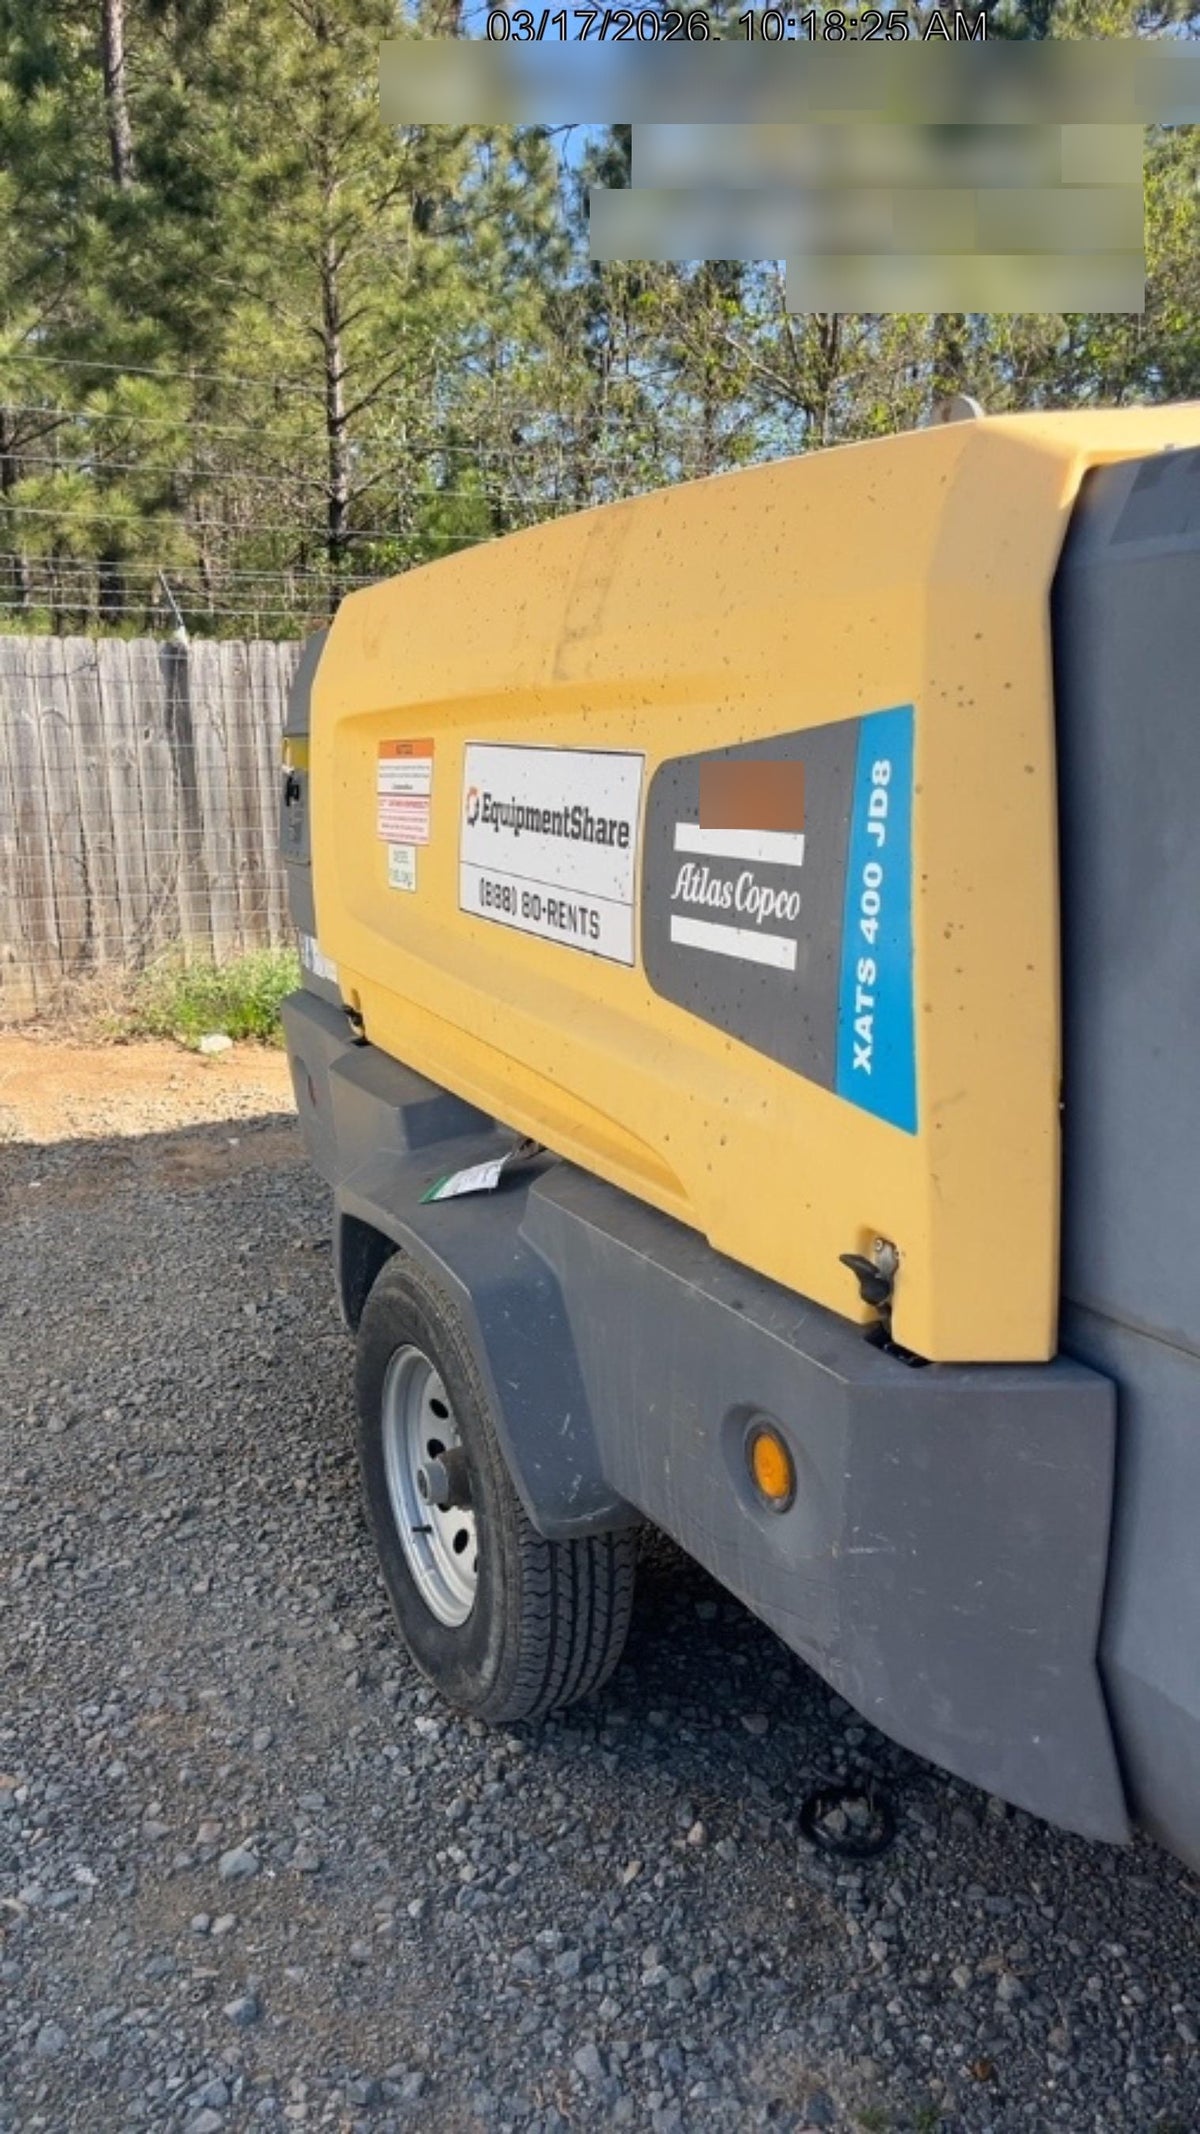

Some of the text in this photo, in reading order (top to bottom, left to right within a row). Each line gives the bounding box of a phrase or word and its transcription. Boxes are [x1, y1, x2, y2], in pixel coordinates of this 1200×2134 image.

[481, 792, 630, 848] EquipmentShare
[479, 877, 601, 940] (888) 80-RENTS
[671, 861, 801, 924] Atlas Copco
[852, 759, 892, 1076] XATS 400 JD8
